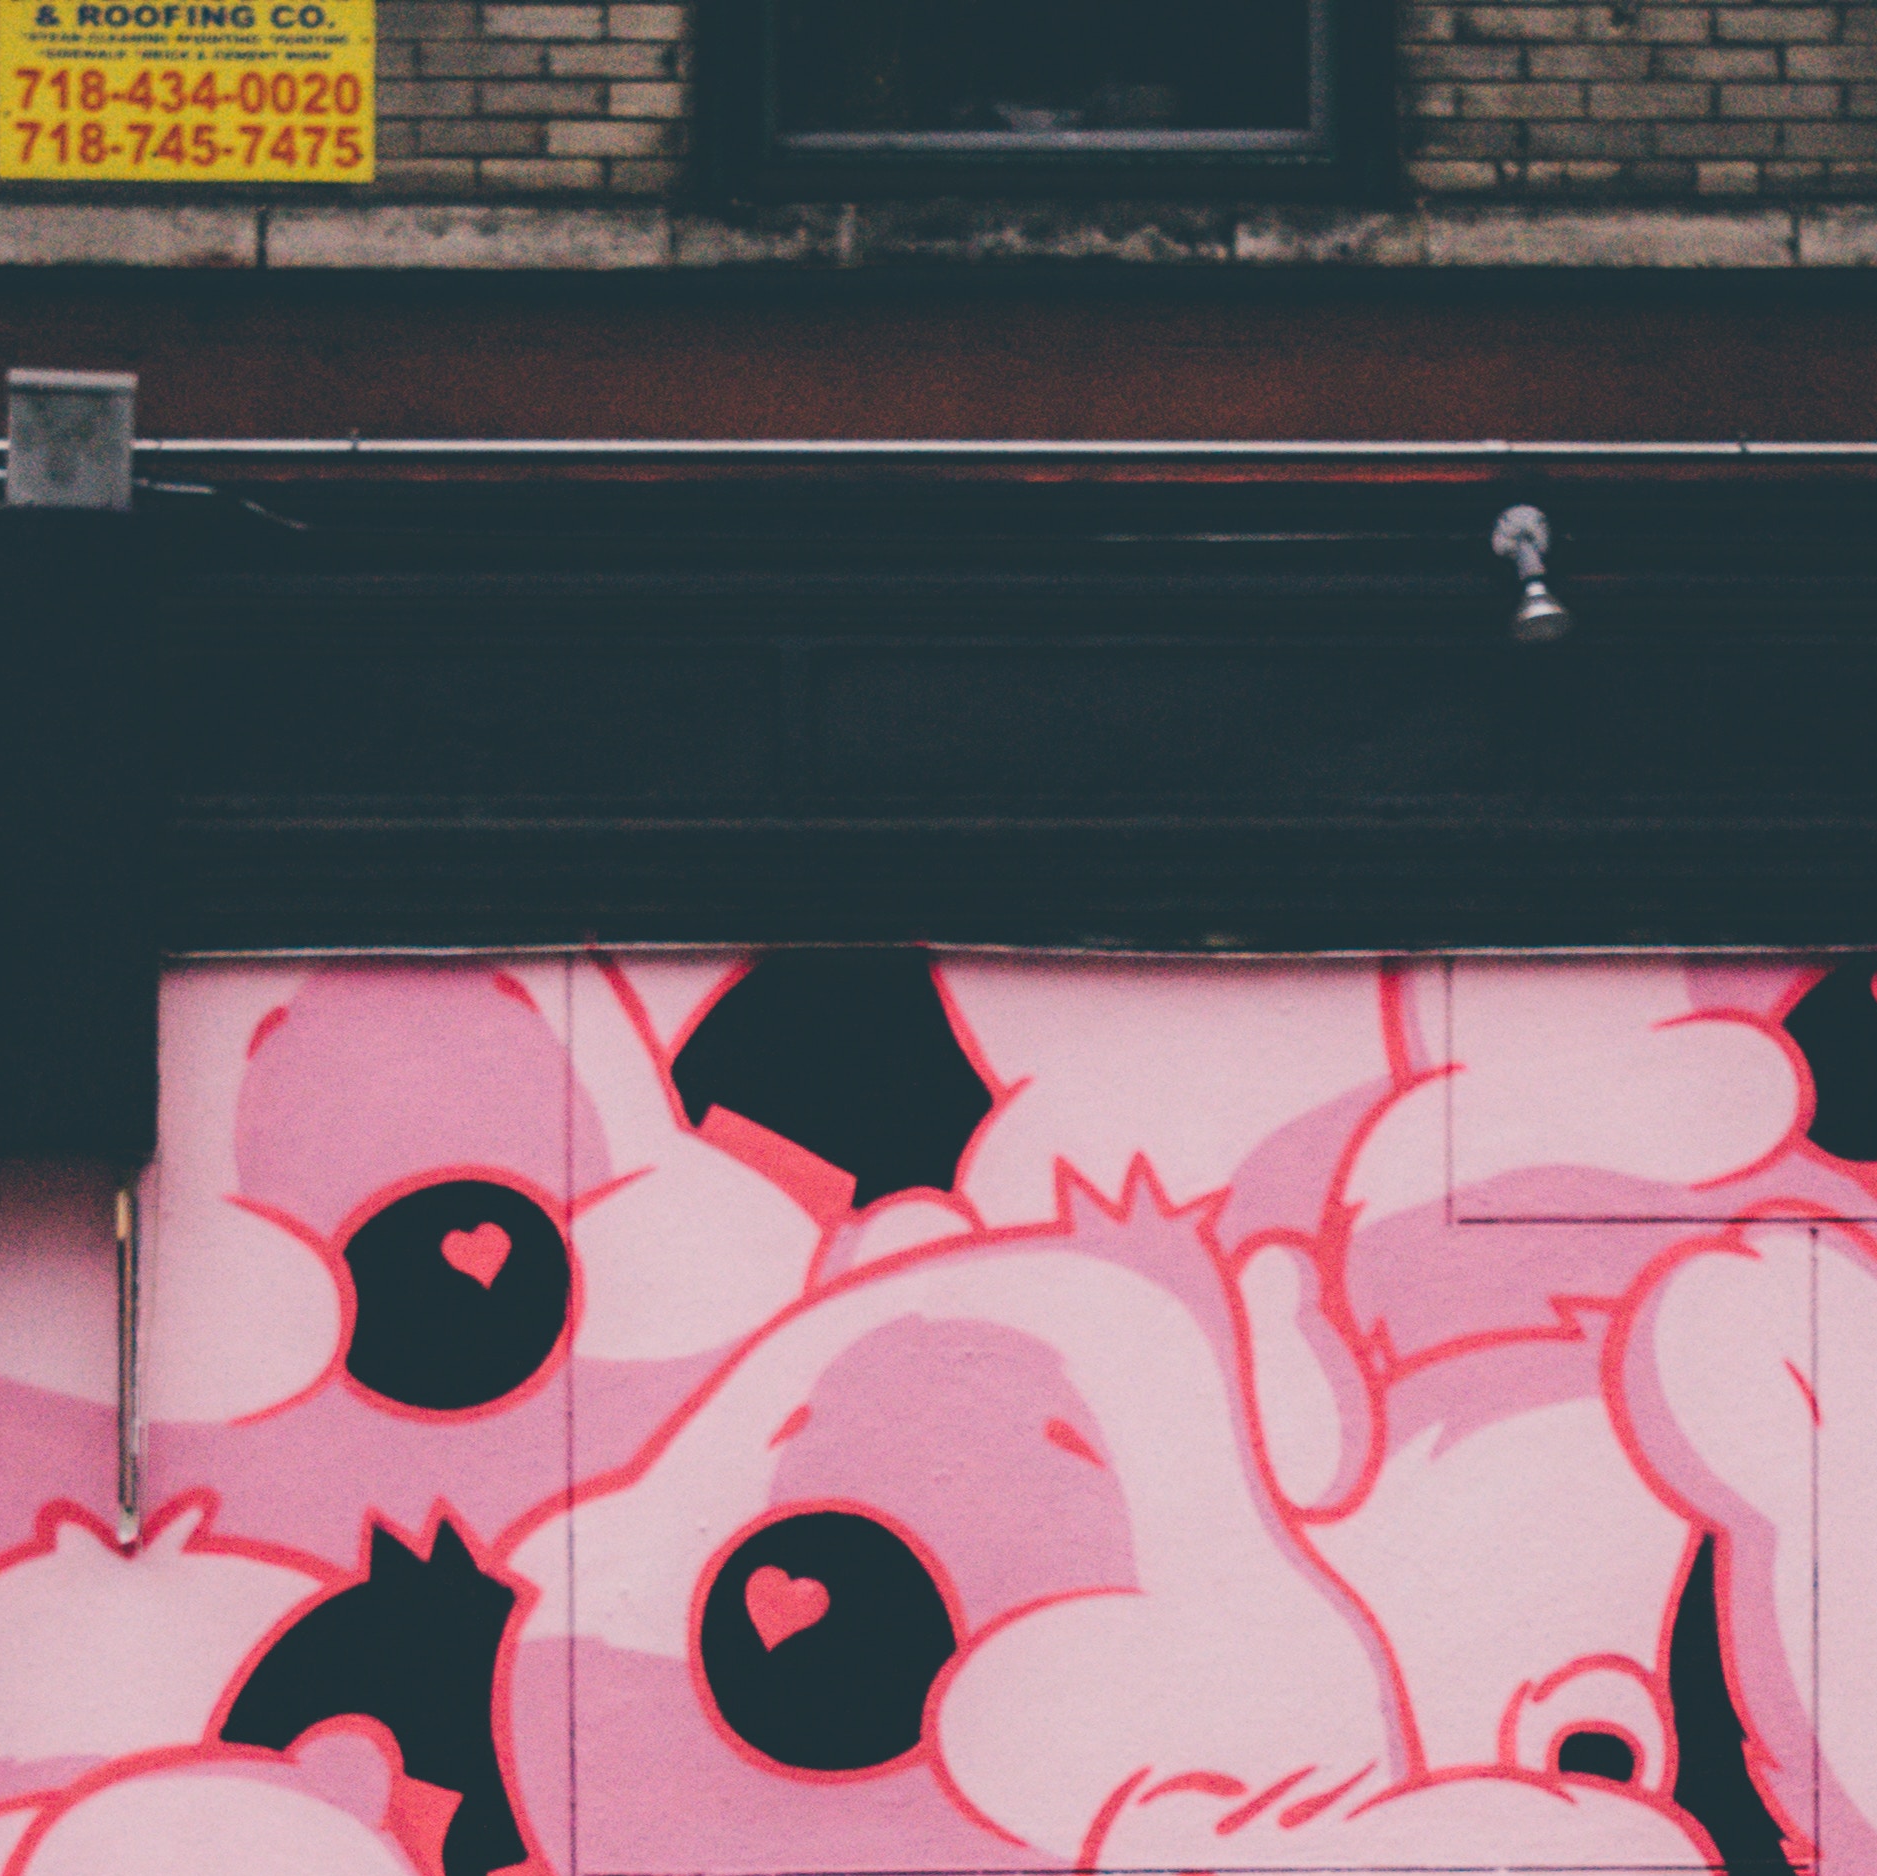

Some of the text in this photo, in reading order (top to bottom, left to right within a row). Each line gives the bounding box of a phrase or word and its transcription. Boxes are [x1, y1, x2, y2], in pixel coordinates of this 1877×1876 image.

[35, 5, 336, 29] & ROOFING CO.
[16, 67, 363, 115] 718-434-0020
[16, 121, 364, 169] 718-745-7475
